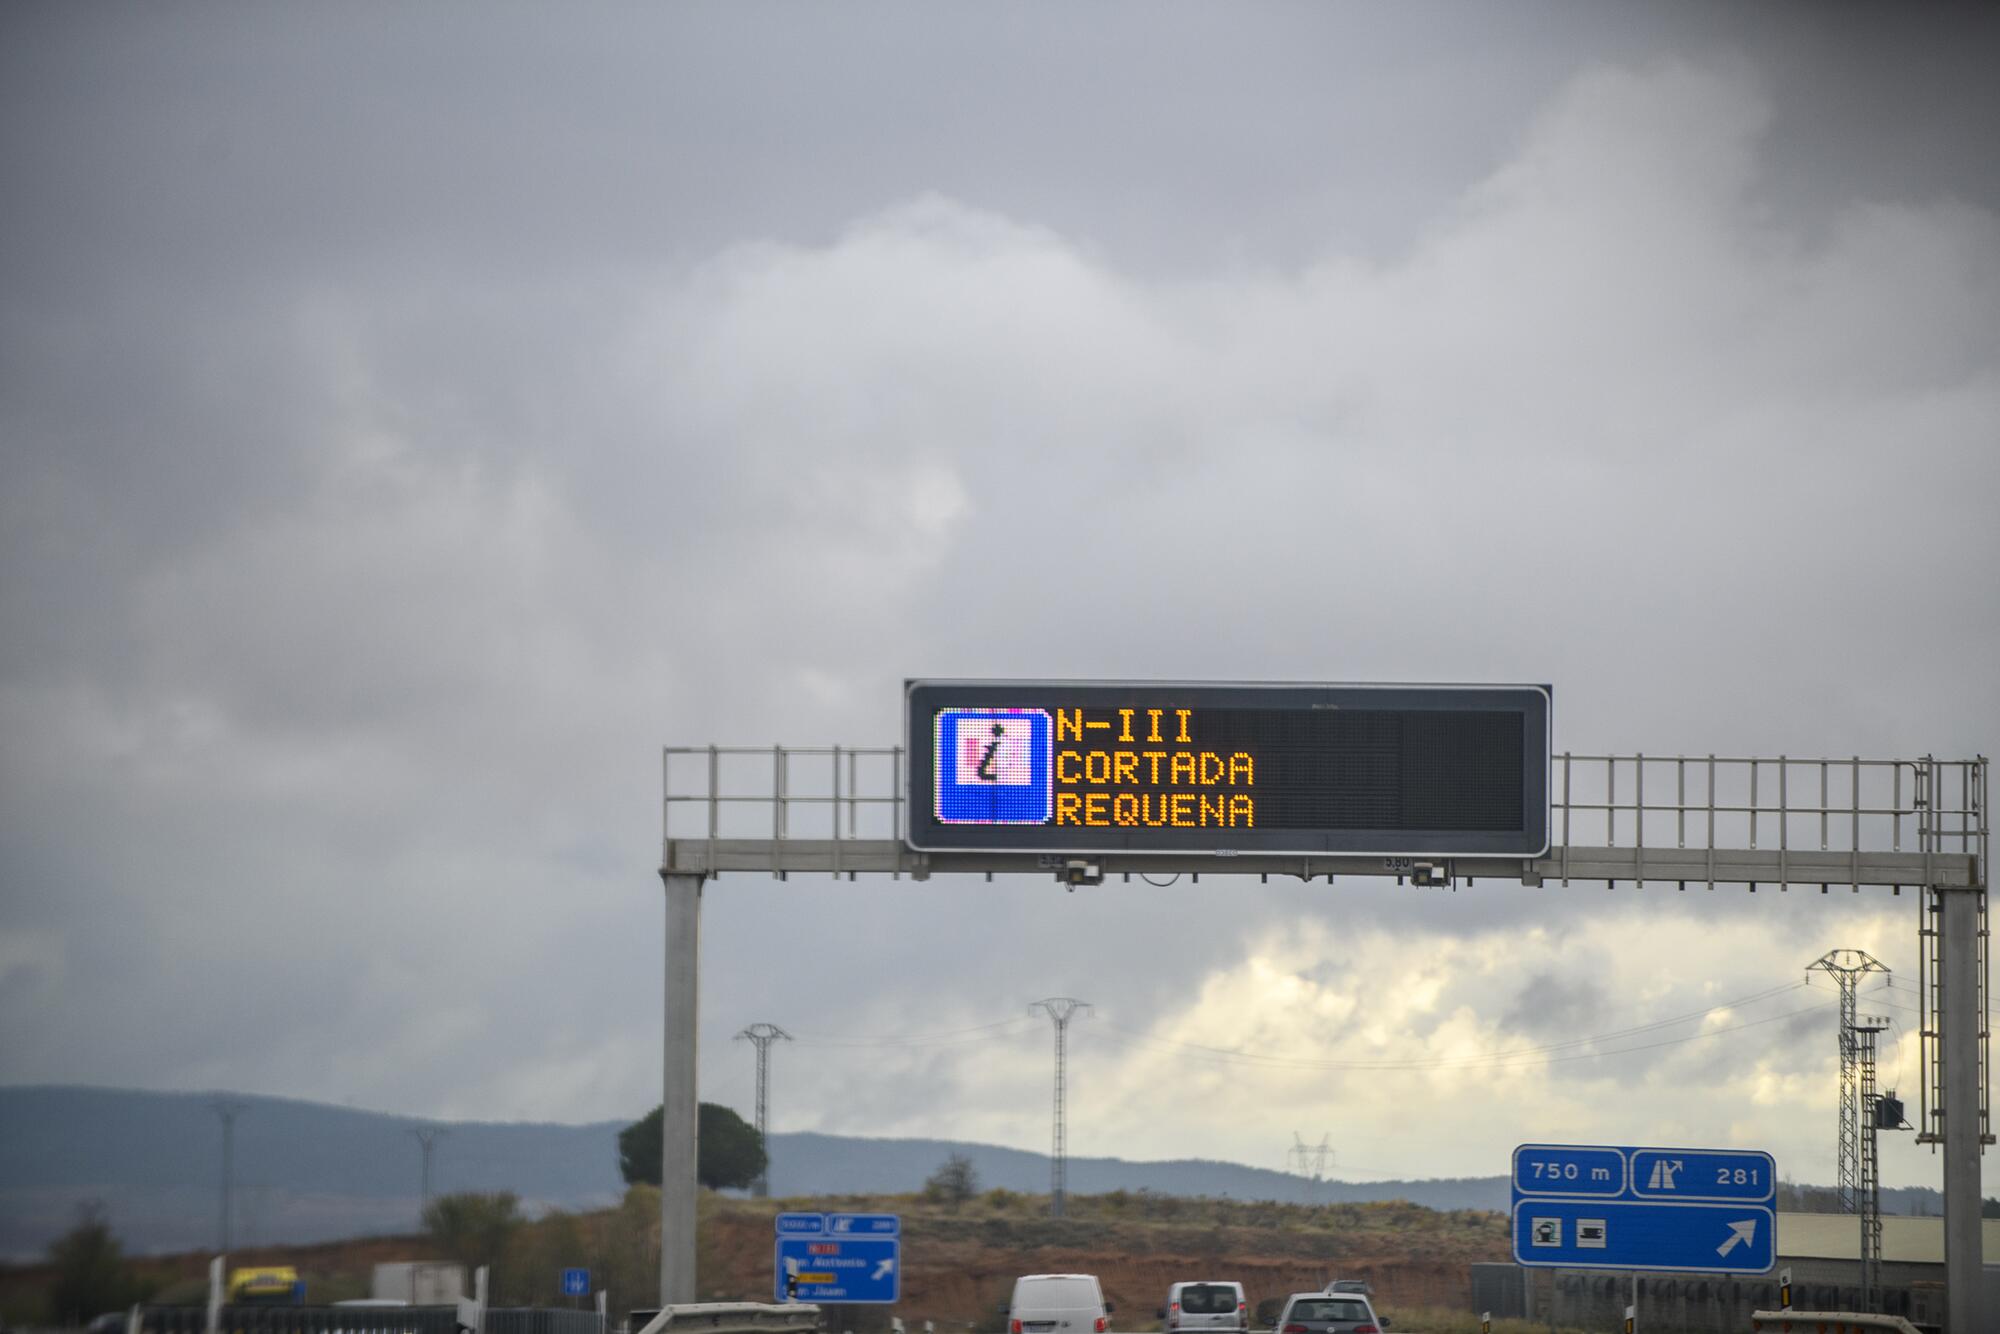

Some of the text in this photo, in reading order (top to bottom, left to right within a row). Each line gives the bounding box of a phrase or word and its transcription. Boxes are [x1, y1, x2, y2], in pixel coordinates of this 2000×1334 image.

[1057, 708, 1192, 742] N-III
[1057, 751, 1254, 785] CORTADA
[1057, 793, 1254, 827] REQUENA
[1531, 1162, 1610, 1181] 750 m
[1716, 1168, 1758, 1185] 281
